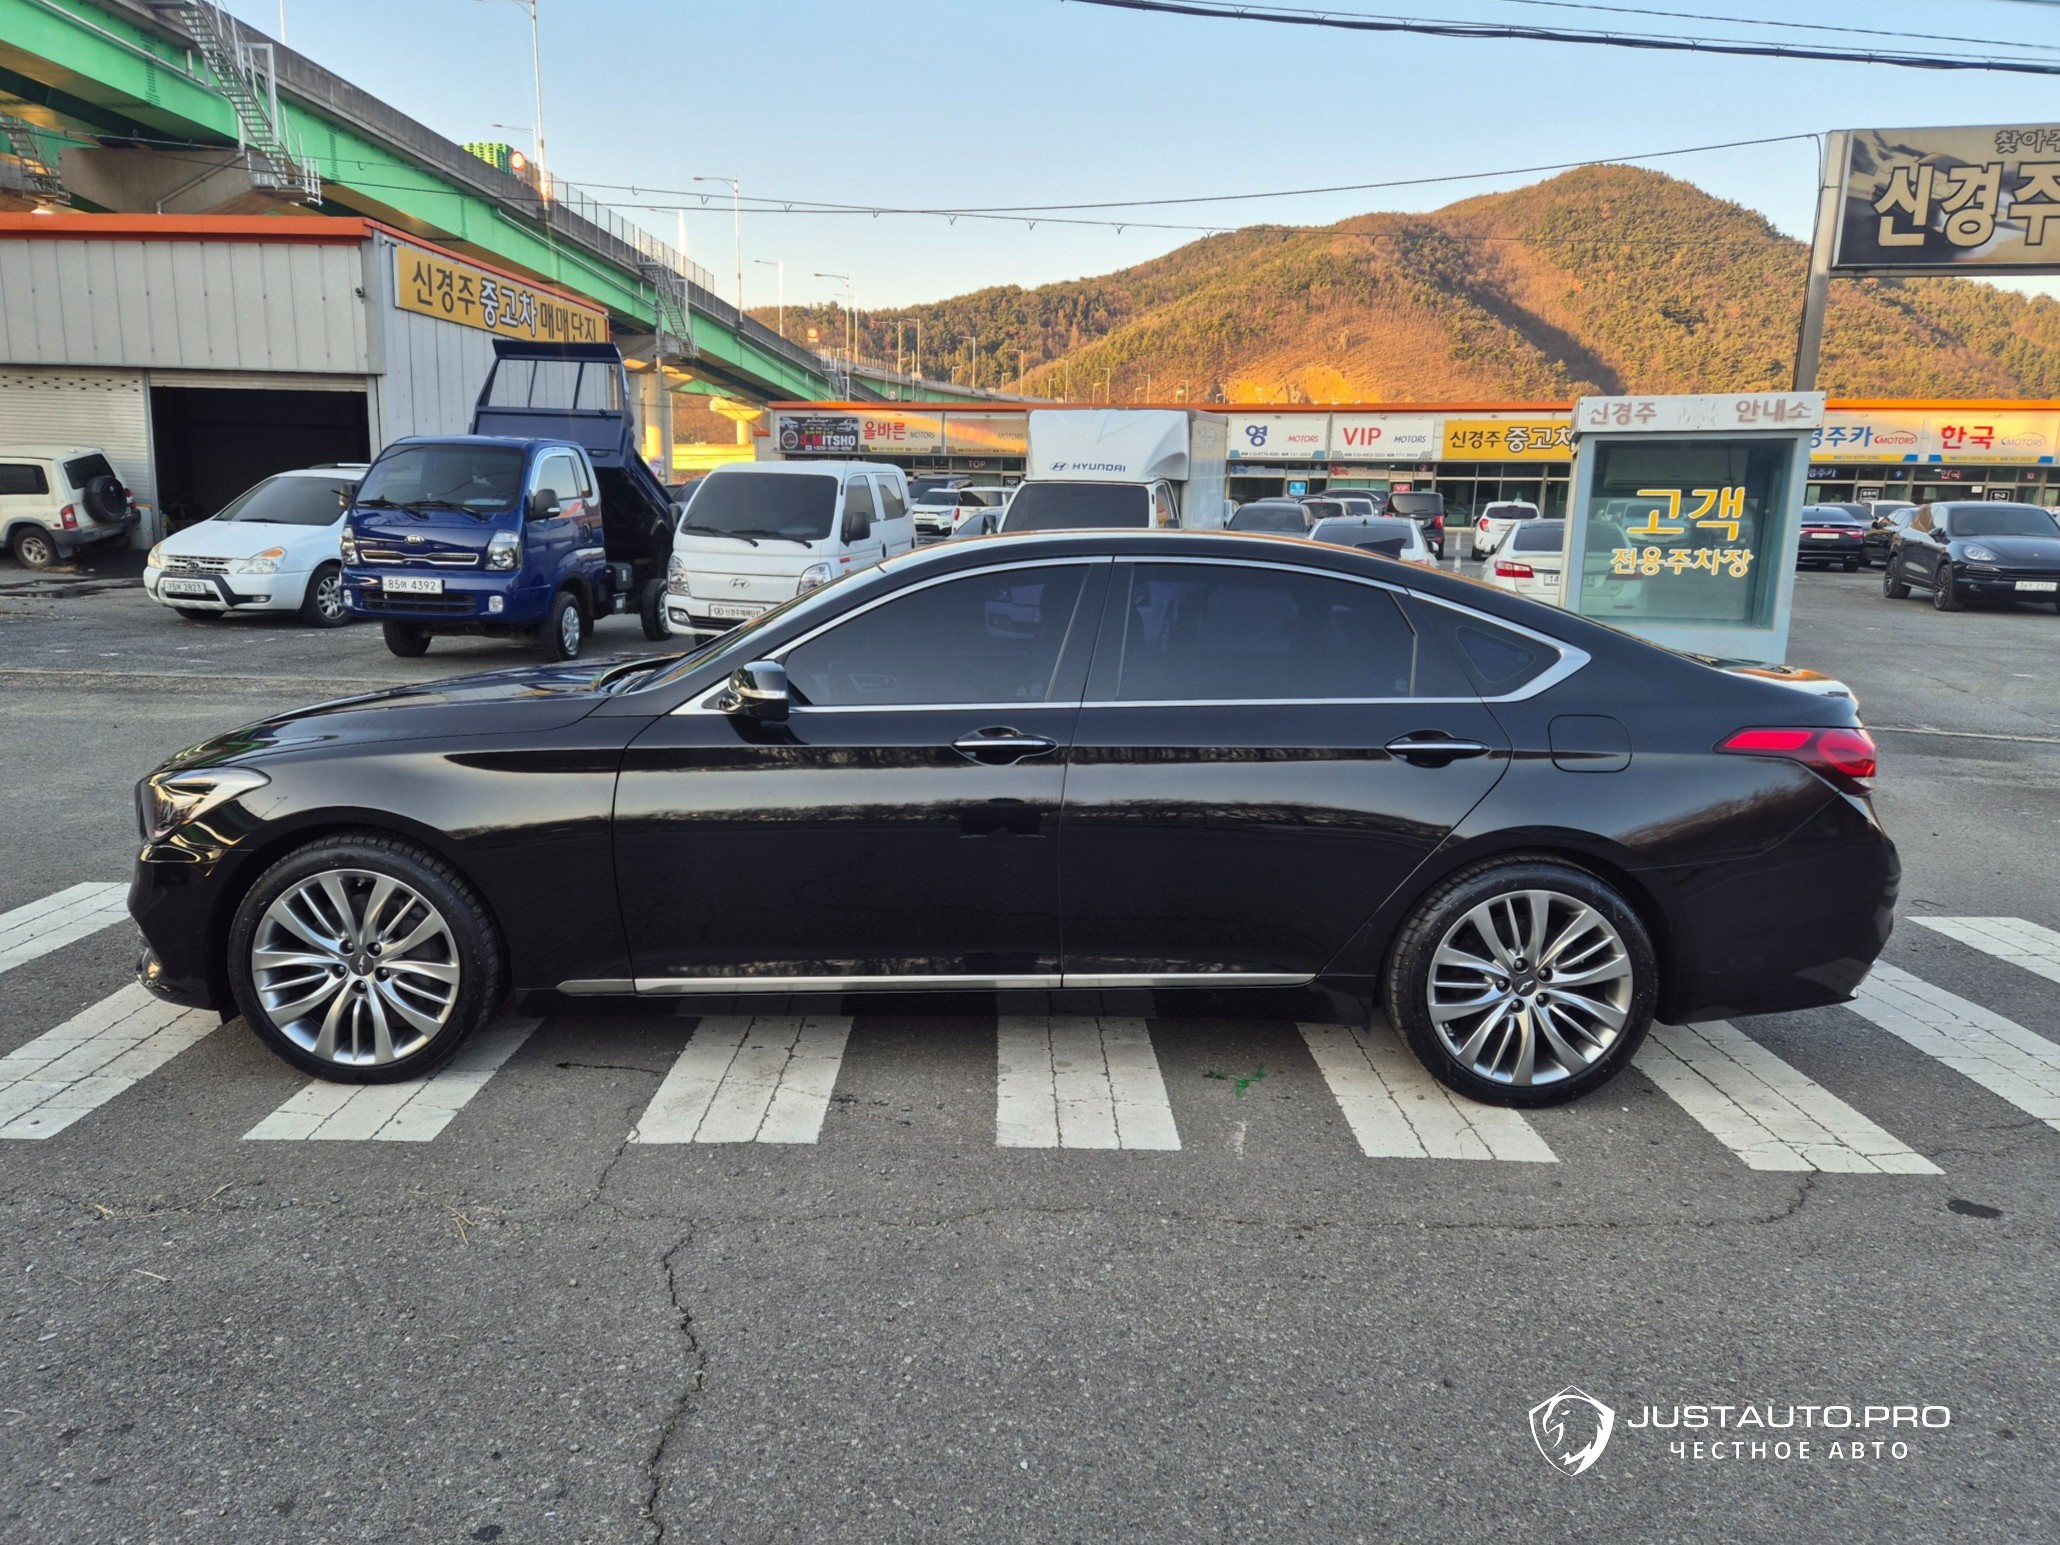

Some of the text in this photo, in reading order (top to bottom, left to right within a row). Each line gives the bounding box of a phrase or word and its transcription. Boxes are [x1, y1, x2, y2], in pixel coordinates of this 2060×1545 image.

[1873, 161, 2060, 247] 신경주
[412, 260, 476, 316] 신경주
[479, 276, 537, 338] 중고차
[1590, 402, 1657, 425] 신경주
[1735, 399, 1812, 423] 안내소
[863, 420, 935, 441] 올바른 MOTORS
[1245, 425, 1319, 447] 영 MOTORS
[1343, 427, 1426, 446] VIP MOTORS
[1450, 430, 1502, 449] 신경주
[1880, 436, 1915, 445] MOTORS
[1941, 426, 2044, 450] 한국 MOTORS
[968, 460, 986, 469] TOP
[1072, 463, 1126, 472] HYUNDAI
[1626, 486, 1746, 542] 고객
[1611, 547, 1754, 578] 전용주차장
[410, 580, 436, 591] 4392
